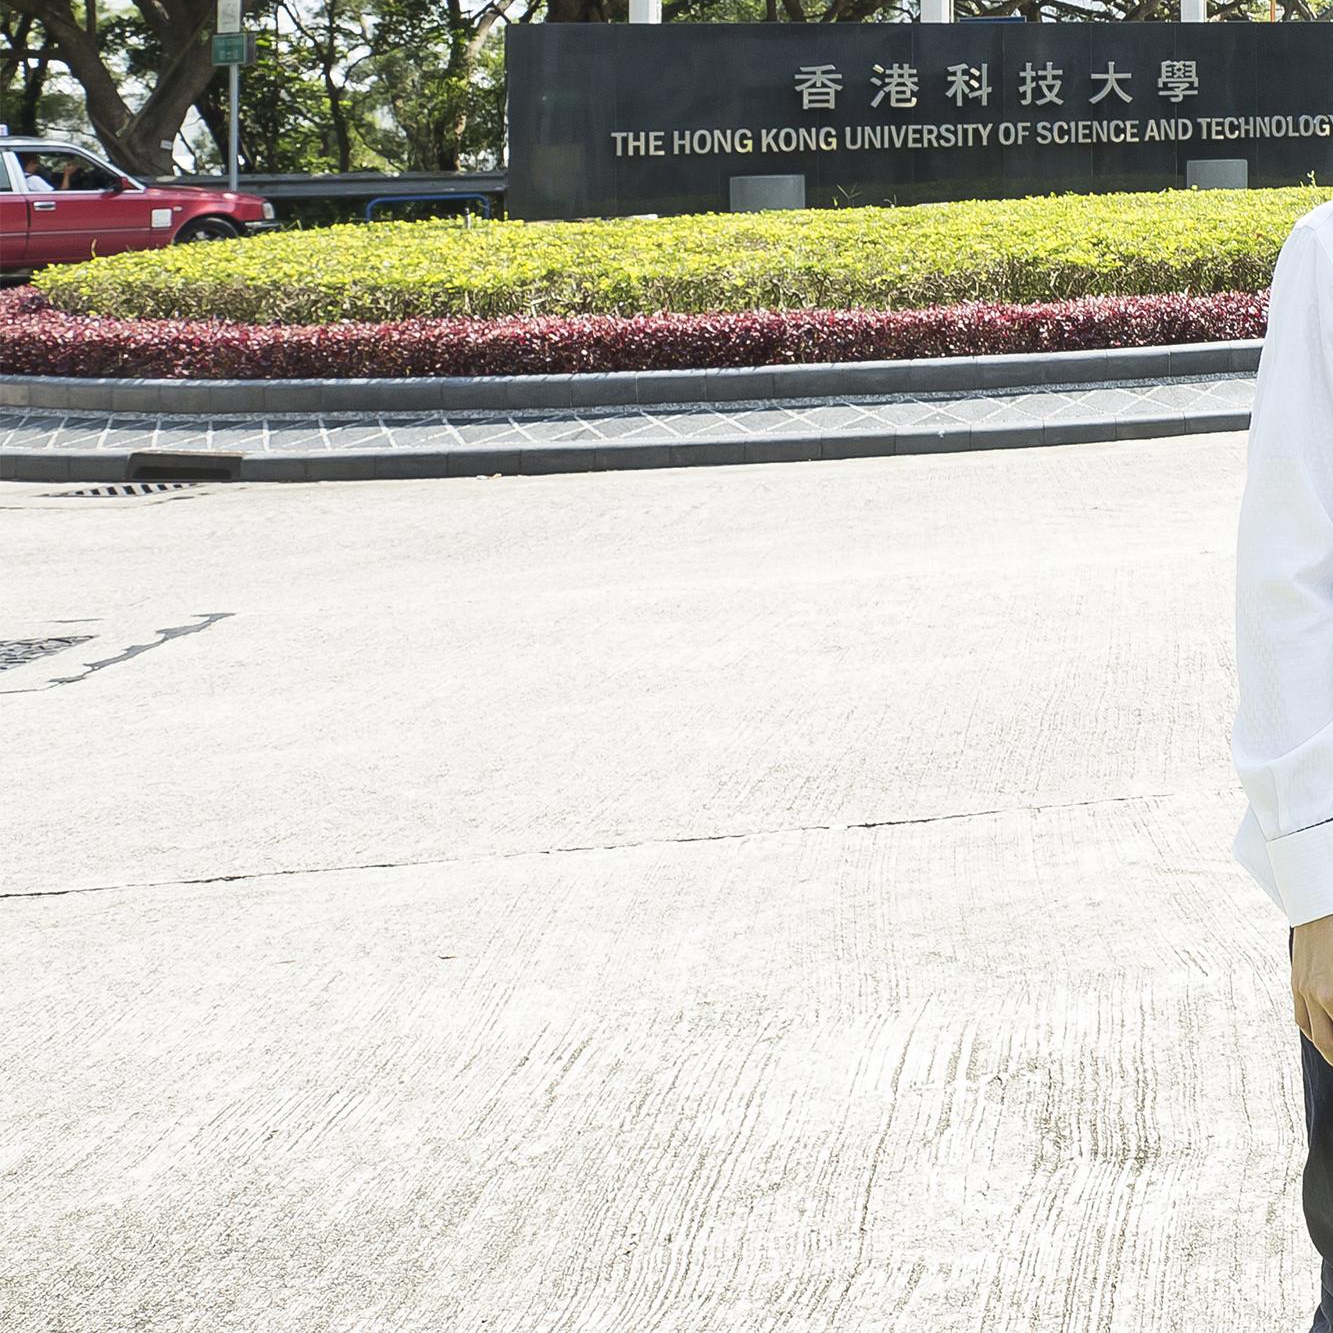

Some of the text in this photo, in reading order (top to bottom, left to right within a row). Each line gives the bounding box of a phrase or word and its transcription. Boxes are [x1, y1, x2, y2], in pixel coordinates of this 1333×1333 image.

[794, 60, 1199, 111] 香港科技大學
[610, 131, 665, 157] THE
[672, 128, 753, 155] HONG
[761, 126, 838, 153] KONG
[845, 122, 993, 151] UNIVERSITY
[998, 121, 1032, 146] OF
[1036, 119, 1140, 145] SCIENCE
[1144, 118, 1193, 142] AND
